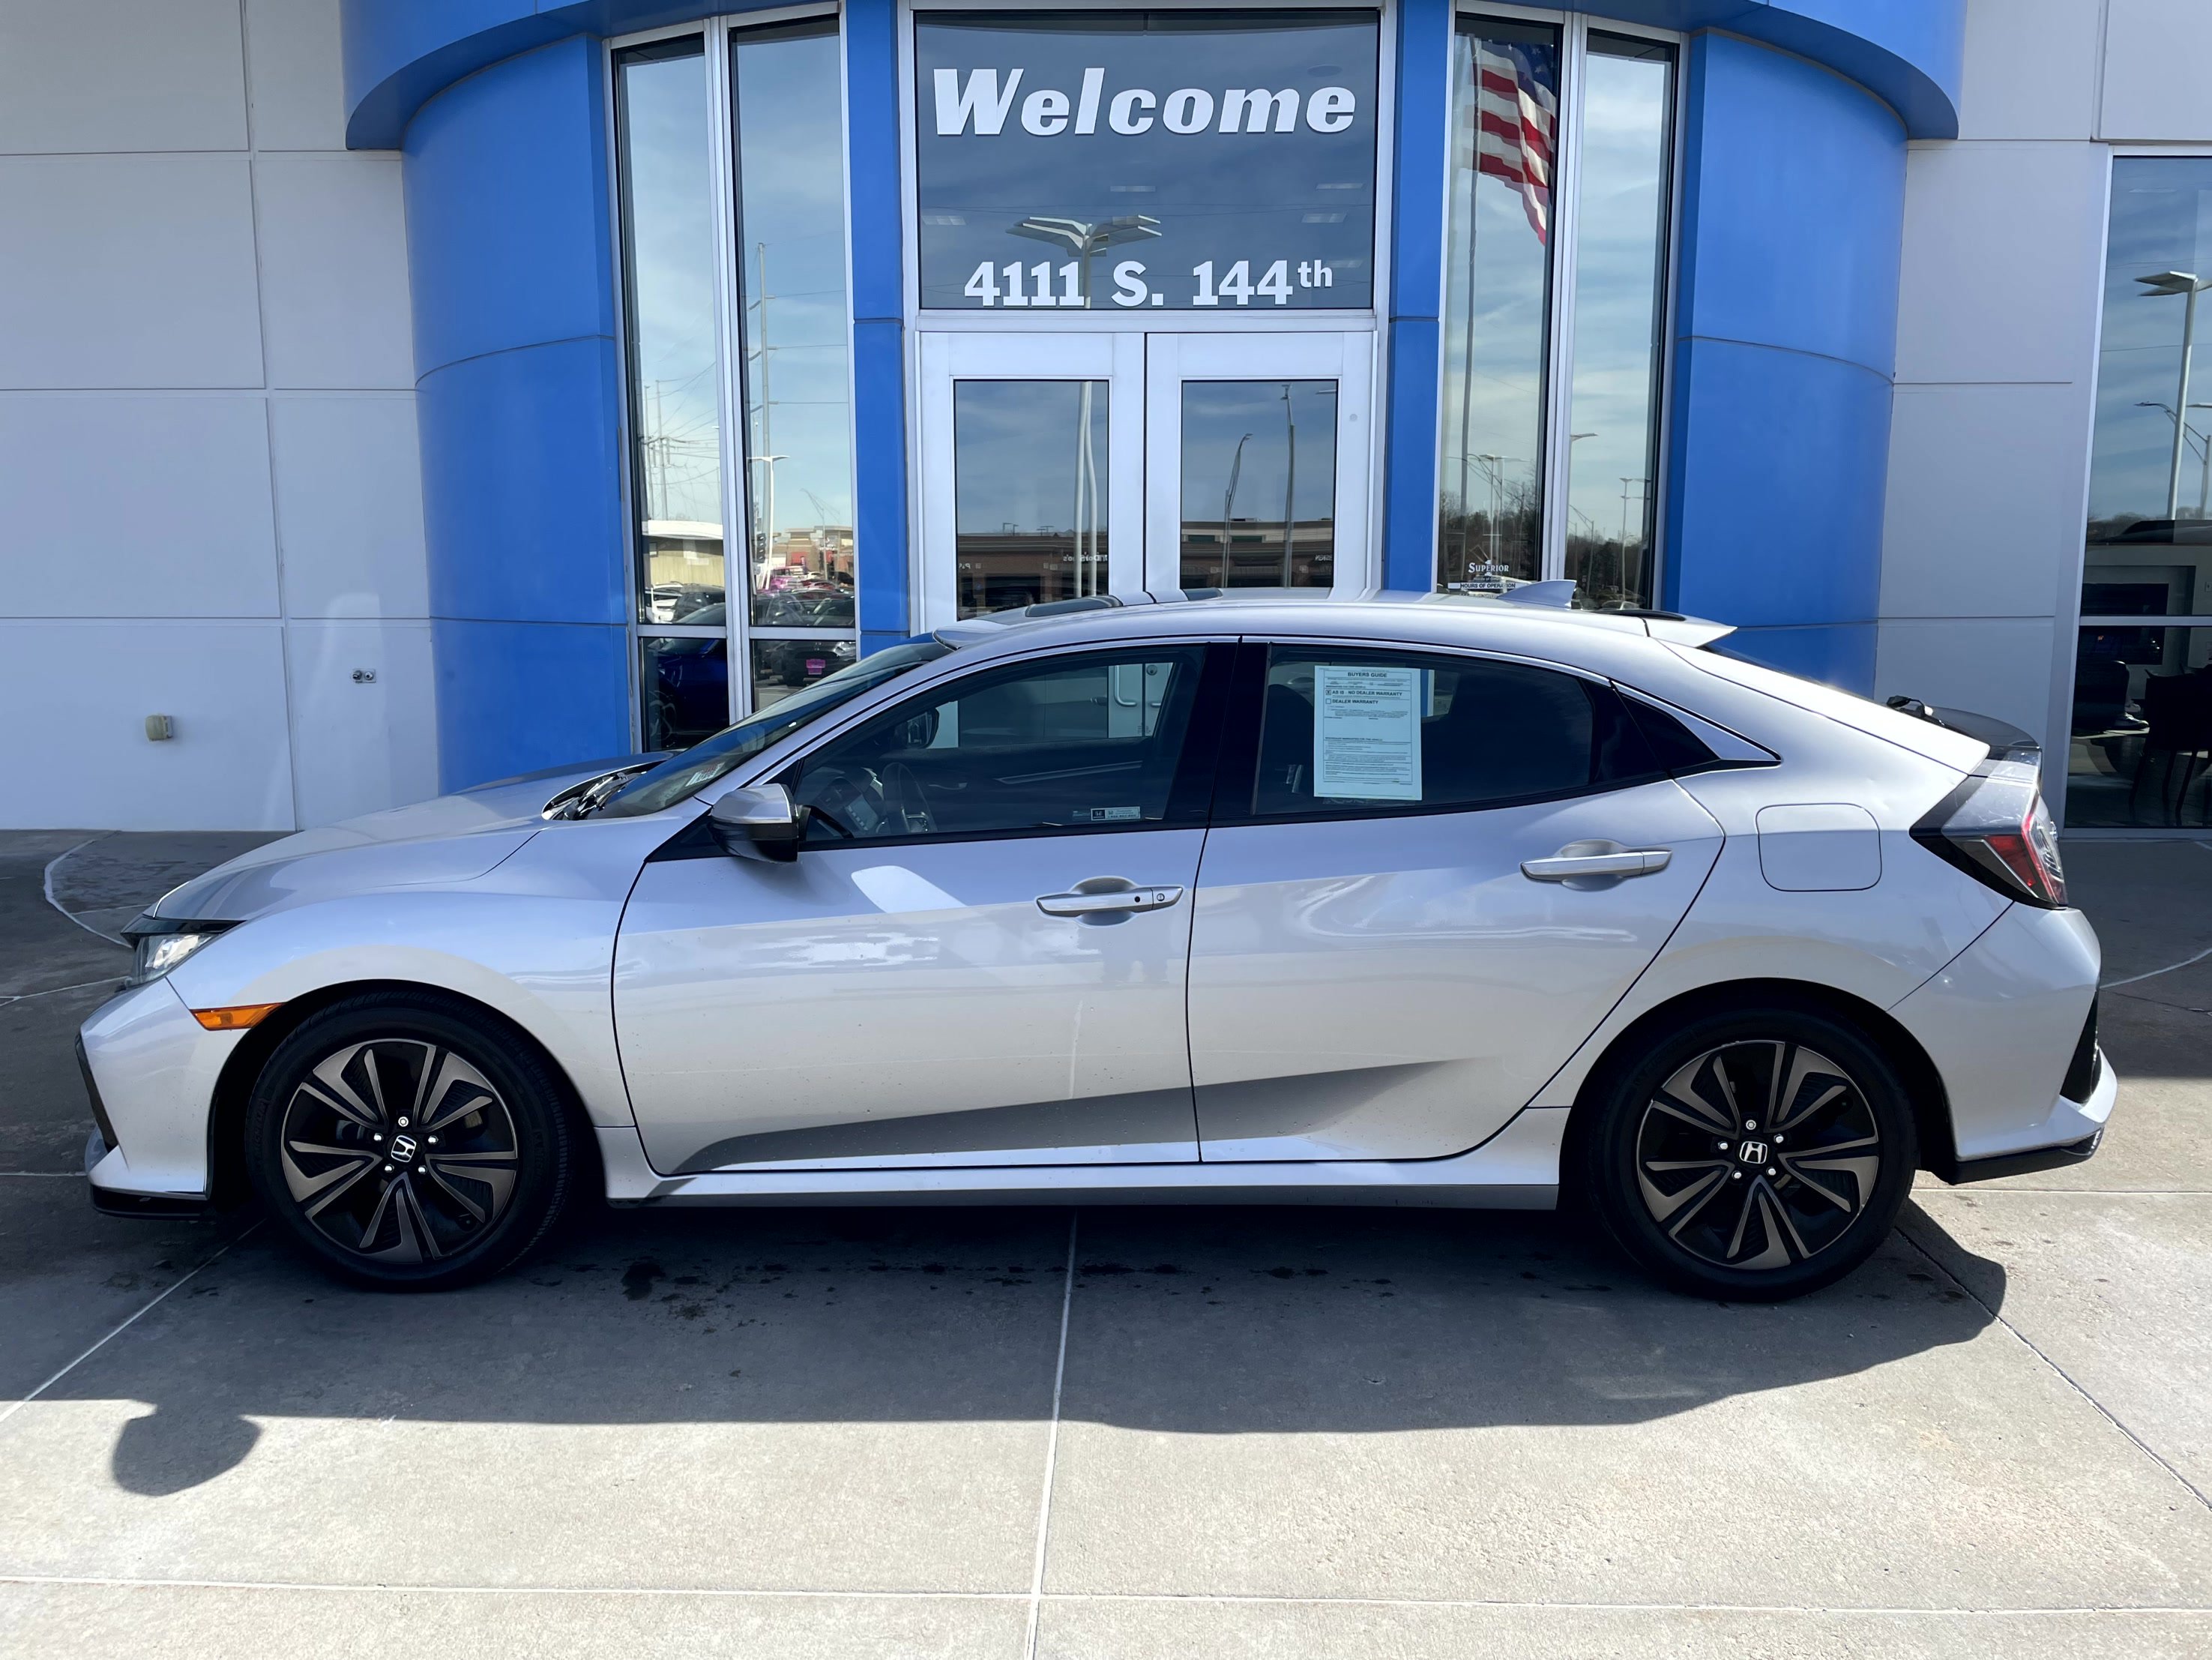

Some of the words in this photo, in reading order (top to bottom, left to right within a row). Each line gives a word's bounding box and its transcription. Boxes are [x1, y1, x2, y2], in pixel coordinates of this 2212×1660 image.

[933, 67, 1357, 136] Welcome
[964, 260, 1085, 307] 4111
[1112, 259, 1164, 307] S.
[1468, 562, 1509, 573] SUPERIOR
